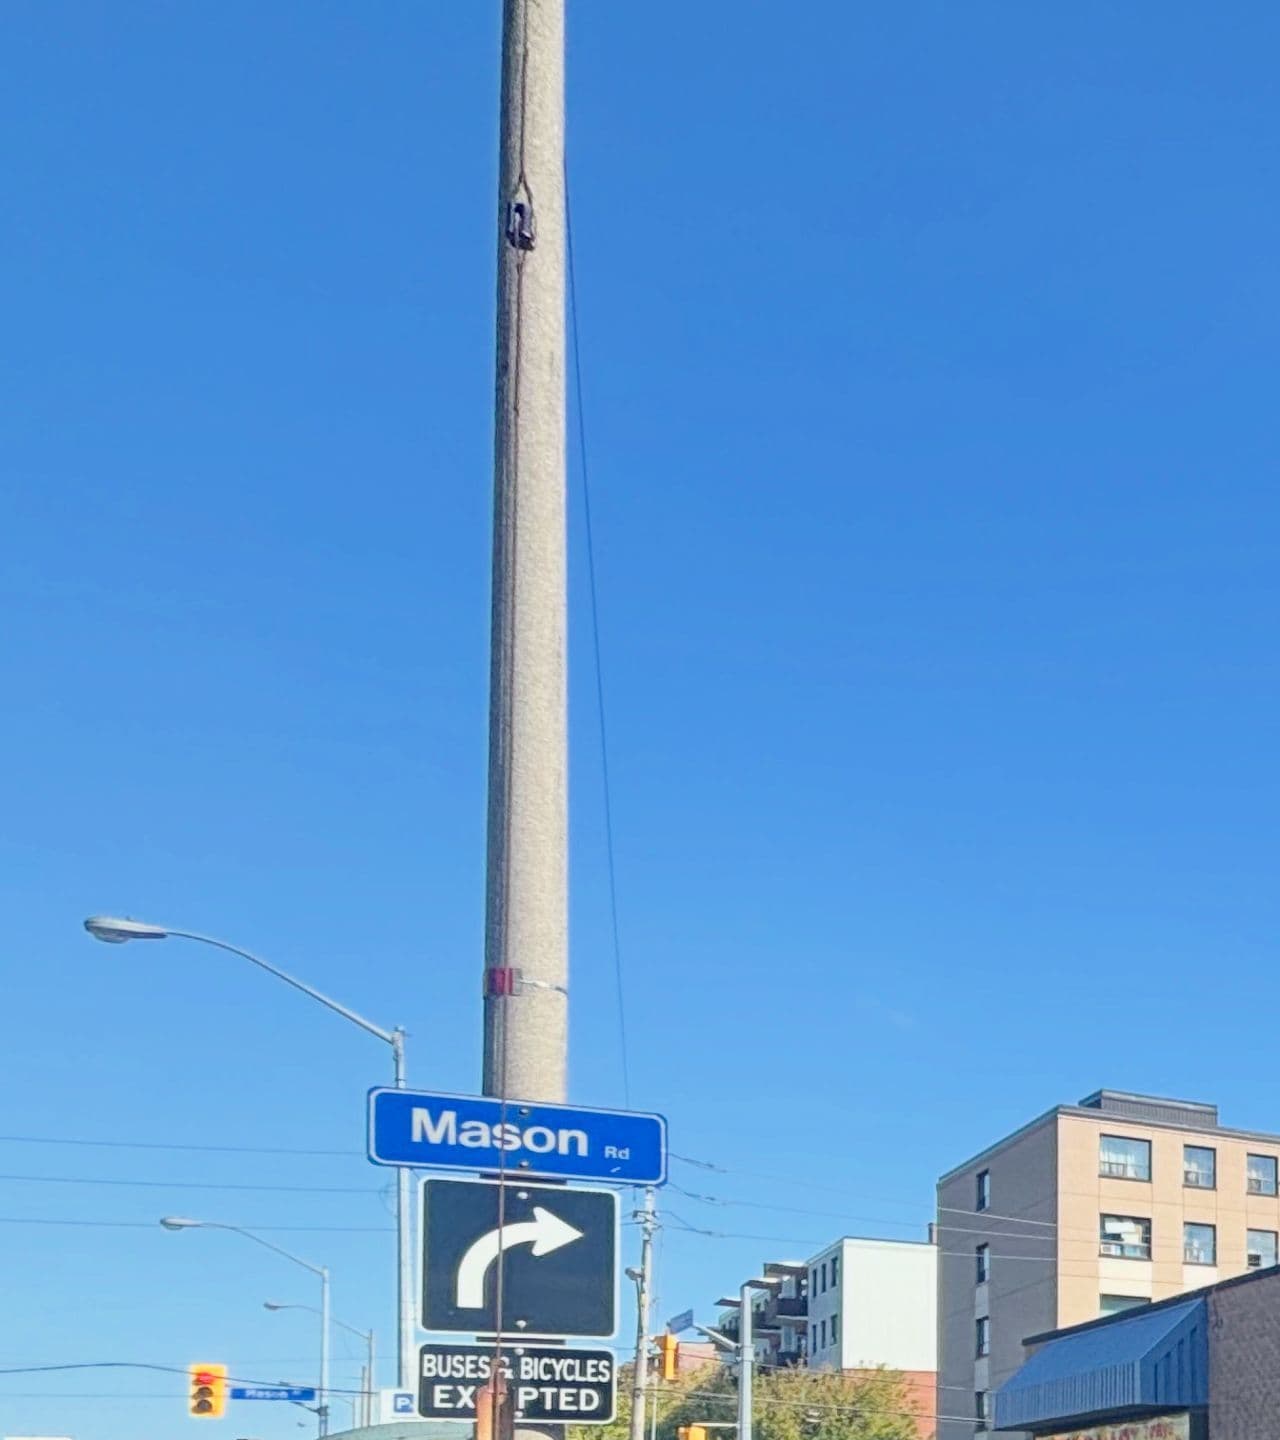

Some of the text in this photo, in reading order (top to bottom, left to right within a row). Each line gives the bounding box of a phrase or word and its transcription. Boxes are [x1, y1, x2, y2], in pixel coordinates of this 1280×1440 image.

[411, 1107, 630, 1160] Mason Rd
[422, 1353, 490, 1378] BUSES
[520, 1357, 610, 1383] BICYCLES
[433, 1385, 600, 1412] EXPTED
